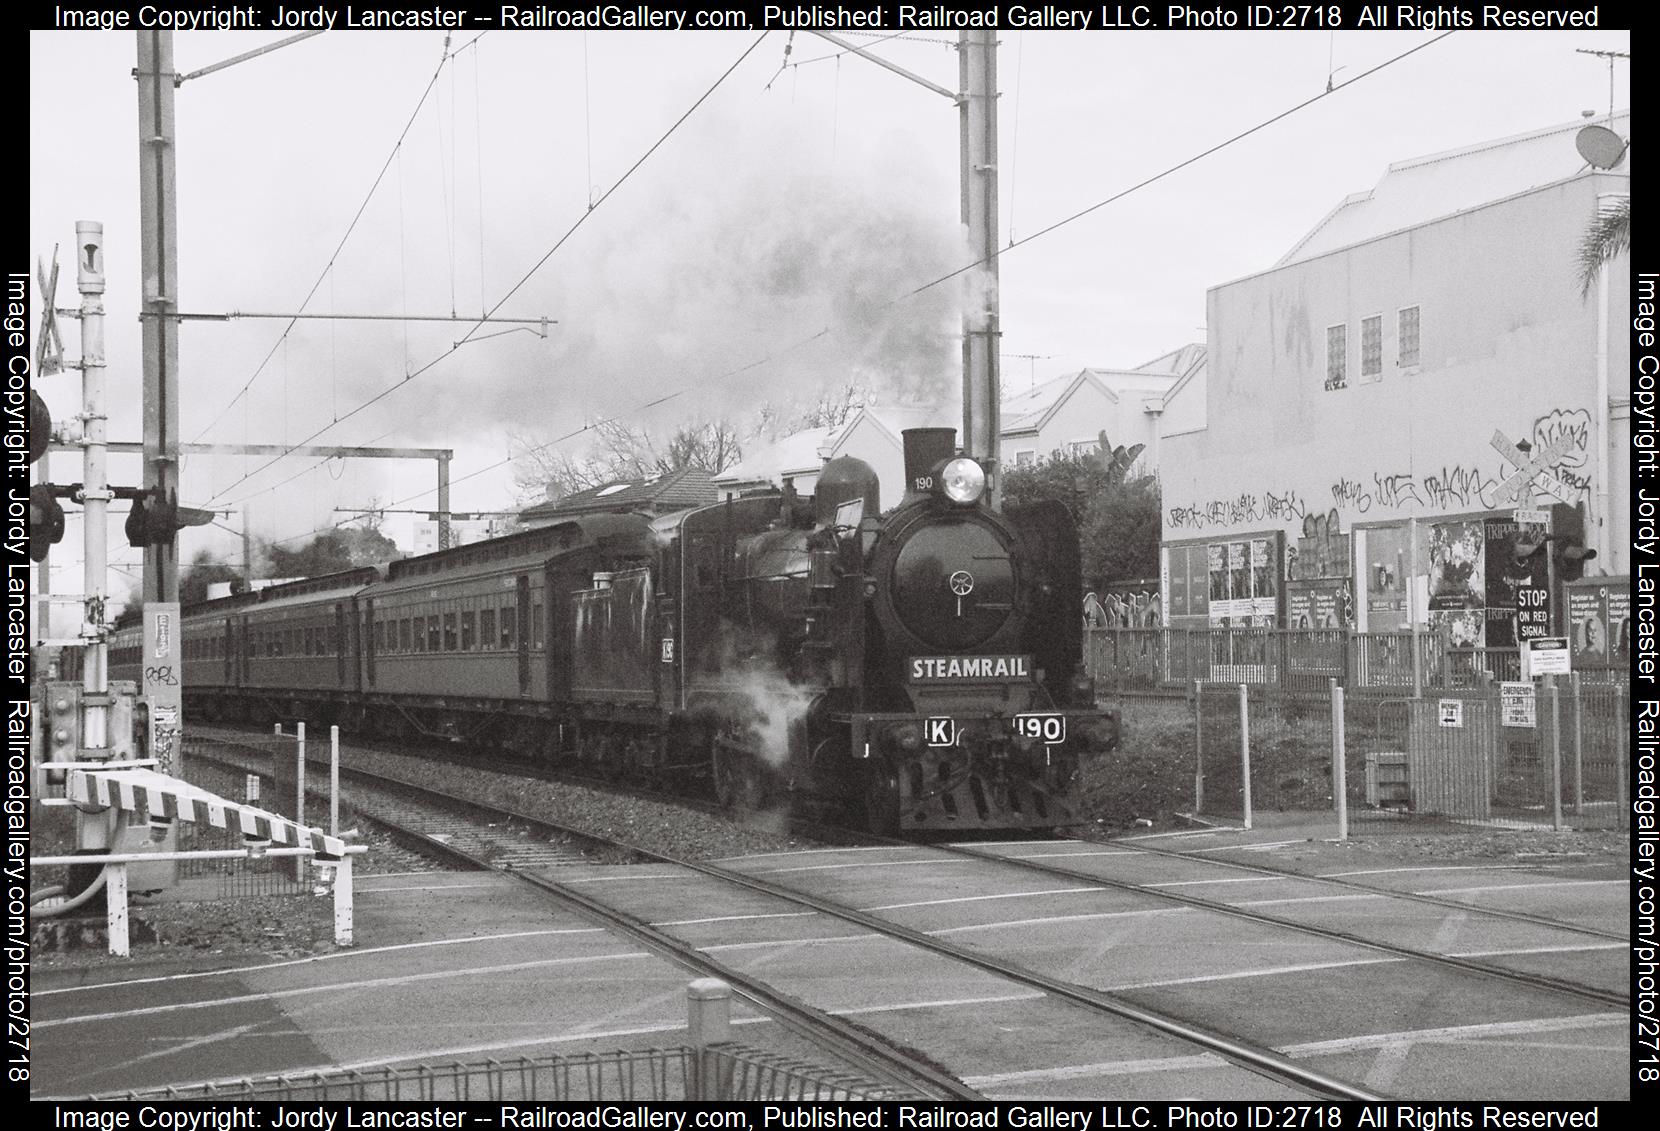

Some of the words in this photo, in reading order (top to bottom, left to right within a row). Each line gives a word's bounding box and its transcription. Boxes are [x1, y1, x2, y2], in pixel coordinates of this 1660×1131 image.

[915, 477, 933, 490] 190
[1519, 589, 1547, 606] STOP
[1519, 611, 1530, 622] ON
[1533, 611, 1548, 622] RED
[1521, 625, 1548, 637] SIGNAL
[913, 658, 1028, 678] STEAMRAIL
[1503, 686, 1532, 695] EMERGENCY
[932, 720, 948, 743] K
[1018, 718, 1061, 740] 190
